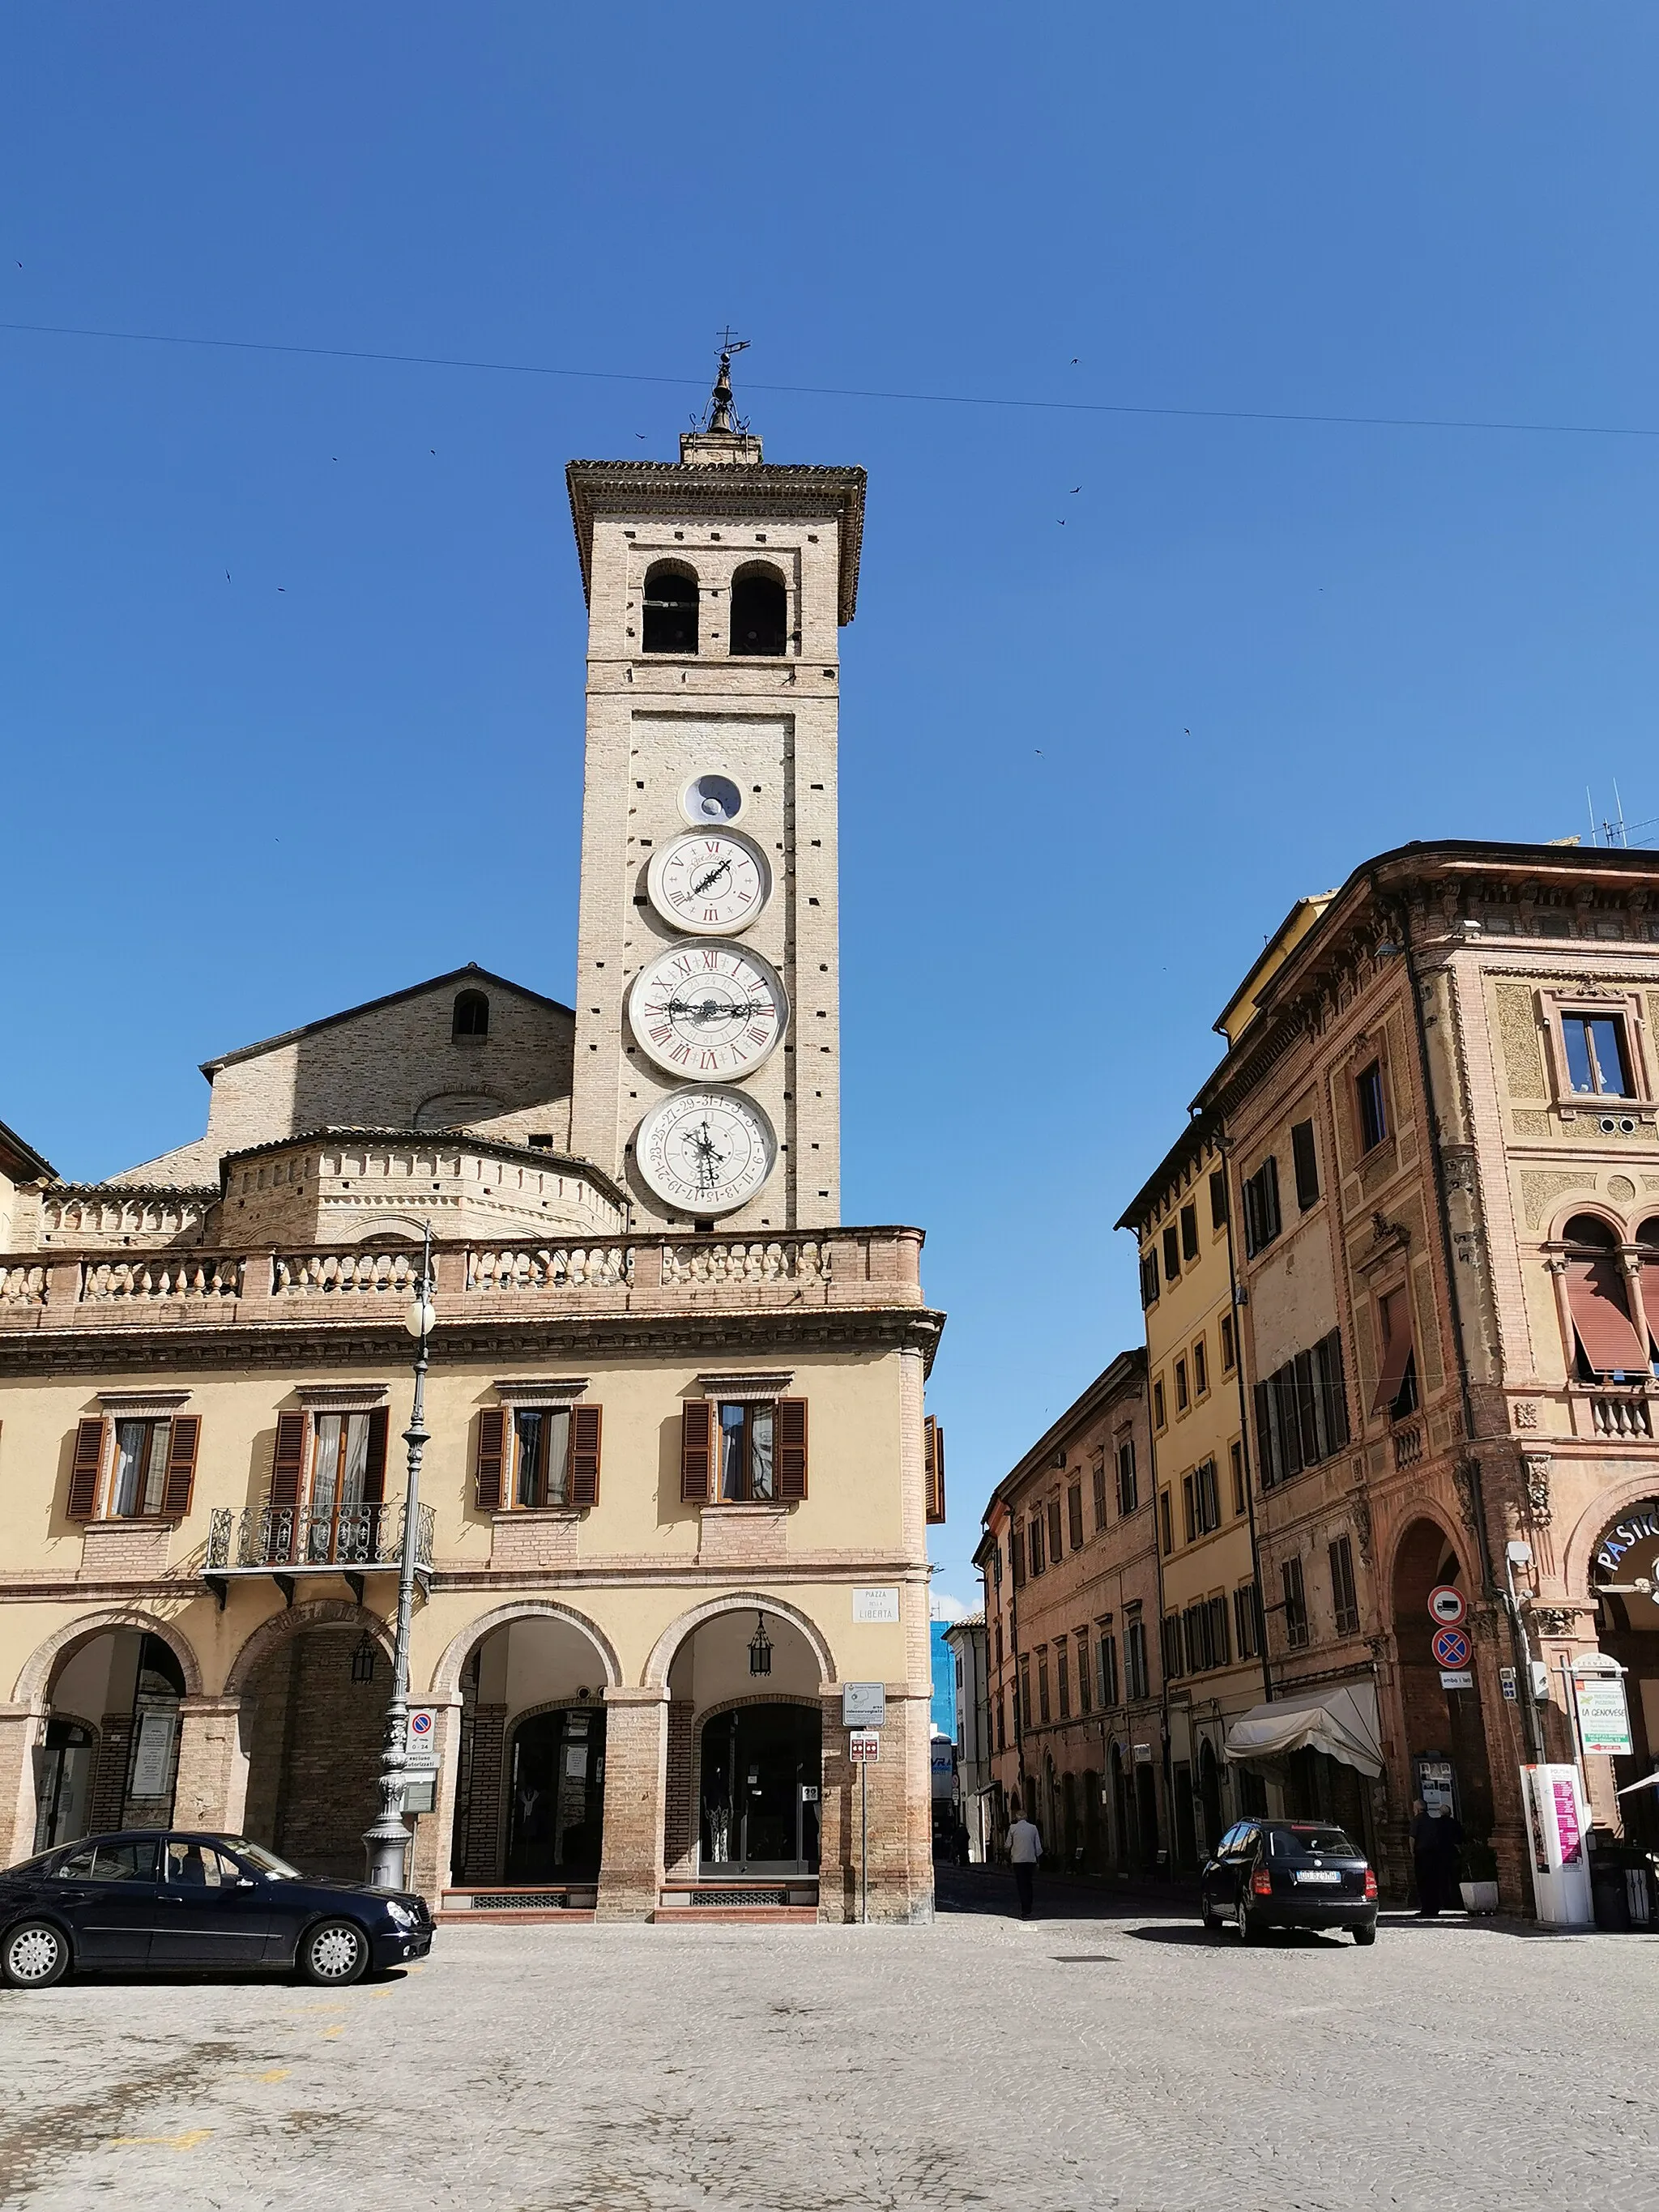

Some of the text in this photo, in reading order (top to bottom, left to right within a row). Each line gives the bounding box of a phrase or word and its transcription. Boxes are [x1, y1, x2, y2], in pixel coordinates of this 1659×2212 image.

[705, 842, 719, 853] VI
[671, 856, 684, 867] V
[737, 891, 753, 903] II
[702, 909, 719, 921] III
[672, 956, 692, 977] XI
[701, 950, 719, 969] XII
[650, 976, 673, 993] X
[749, 976, 769, 992] II
[648, 1025, 673, 1047] VIII
[746, 1026, 770, 1047] IIII
[668, 1043, 691, 1065] VII
[699, 1052, 719, 1070] VI
[731, 1046, 748, 1065] V
[679, 1098, 695, 1111] 29
[731, 1101, 742, 1114] 3
[662, 1109, 677, 1124] 27
[745, 1118, 759, 1127] 5
[653, 1128, 666, 1142] 25
[753, 1137, 765, 1147] 7
[649, 1149, 663, 1161] 23
[654, 1167, 667, 1181] 21
[667, 1180, 682, 1194] 19
[724, 1183, 740, 1200] 13
[706, 1191, 721, 1204] 15
[859, 1608, 892, 1618] LIBERTÀ
[1582, 1708, 1626, 1717] LA GENOVESE
